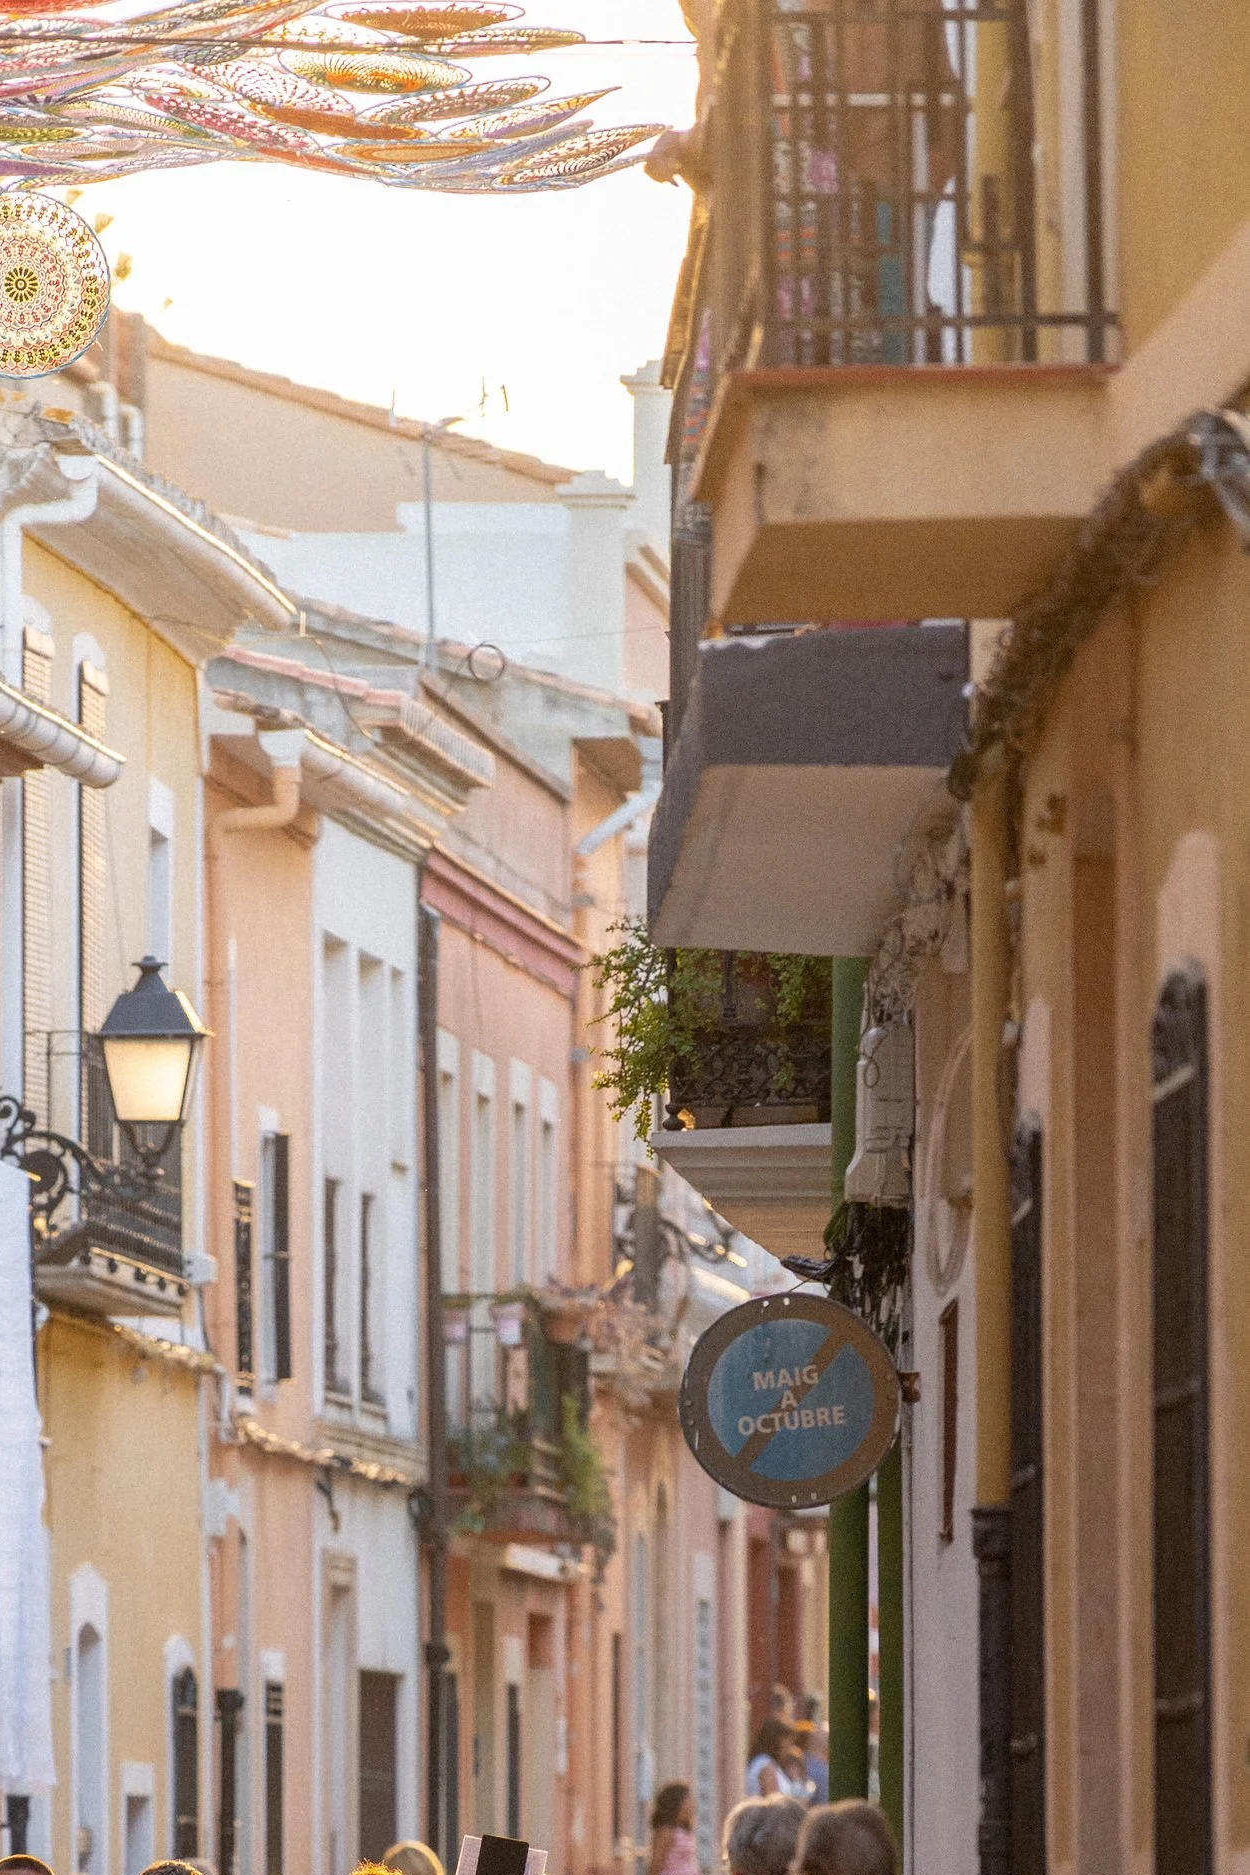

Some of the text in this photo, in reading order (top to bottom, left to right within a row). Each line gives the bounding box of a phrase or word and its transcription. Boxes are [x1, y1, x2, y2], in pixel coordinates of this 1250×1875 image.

[752, 1364, 819, 1392] MAIG
[781, 1390, 798, 1410] A
[737, 1405, 846, 1437] OCTUBRE
